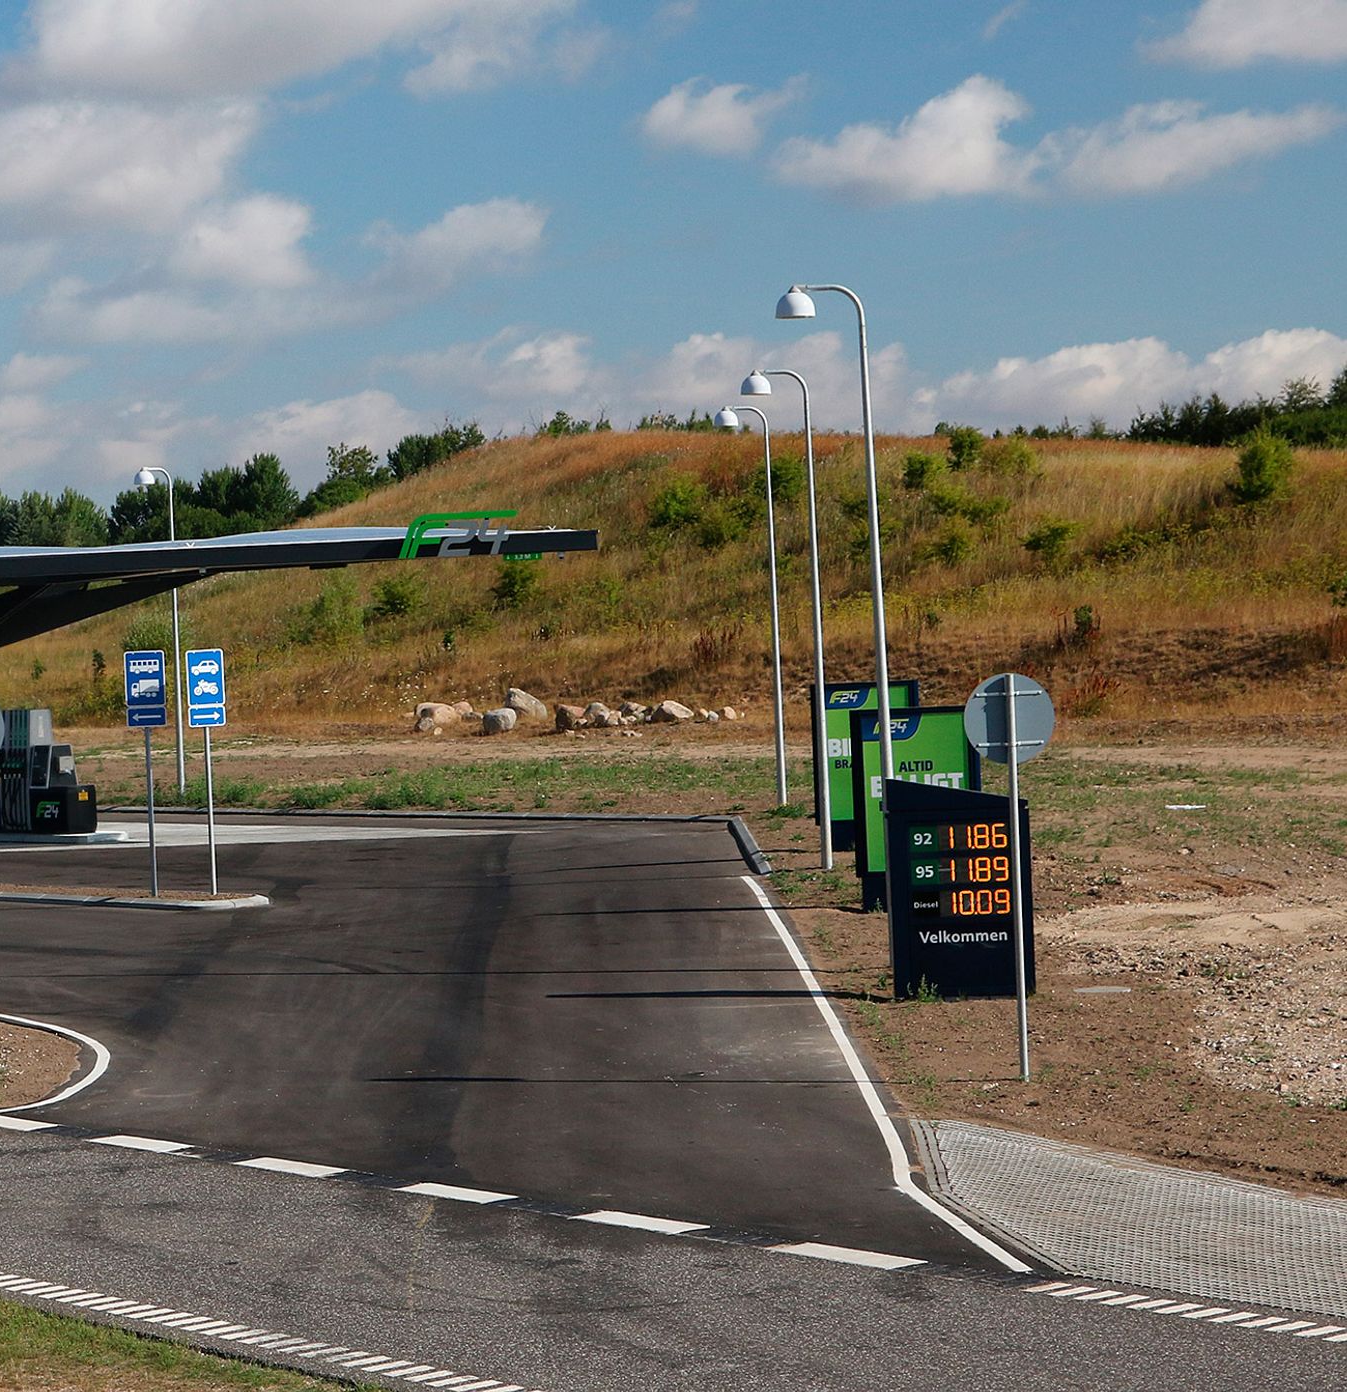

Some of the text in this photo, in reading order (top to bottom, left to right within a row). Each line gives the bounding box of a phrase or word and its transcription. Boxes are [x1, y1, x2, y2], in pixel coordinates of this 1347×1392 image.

[399, 510, 519, 559] F24
[829, 689, 860, 704] F24
[899, 761, 933, 772] ALTID
[36, 801, 60, 818] F24
[913, 823, 1008, 849] 92 11.86
[915, 856, 1009, 882] 95 11.89
[913, 889, 1011, 915] Diesel 10.09
[919, 930, 1008, 944] Velkommen
